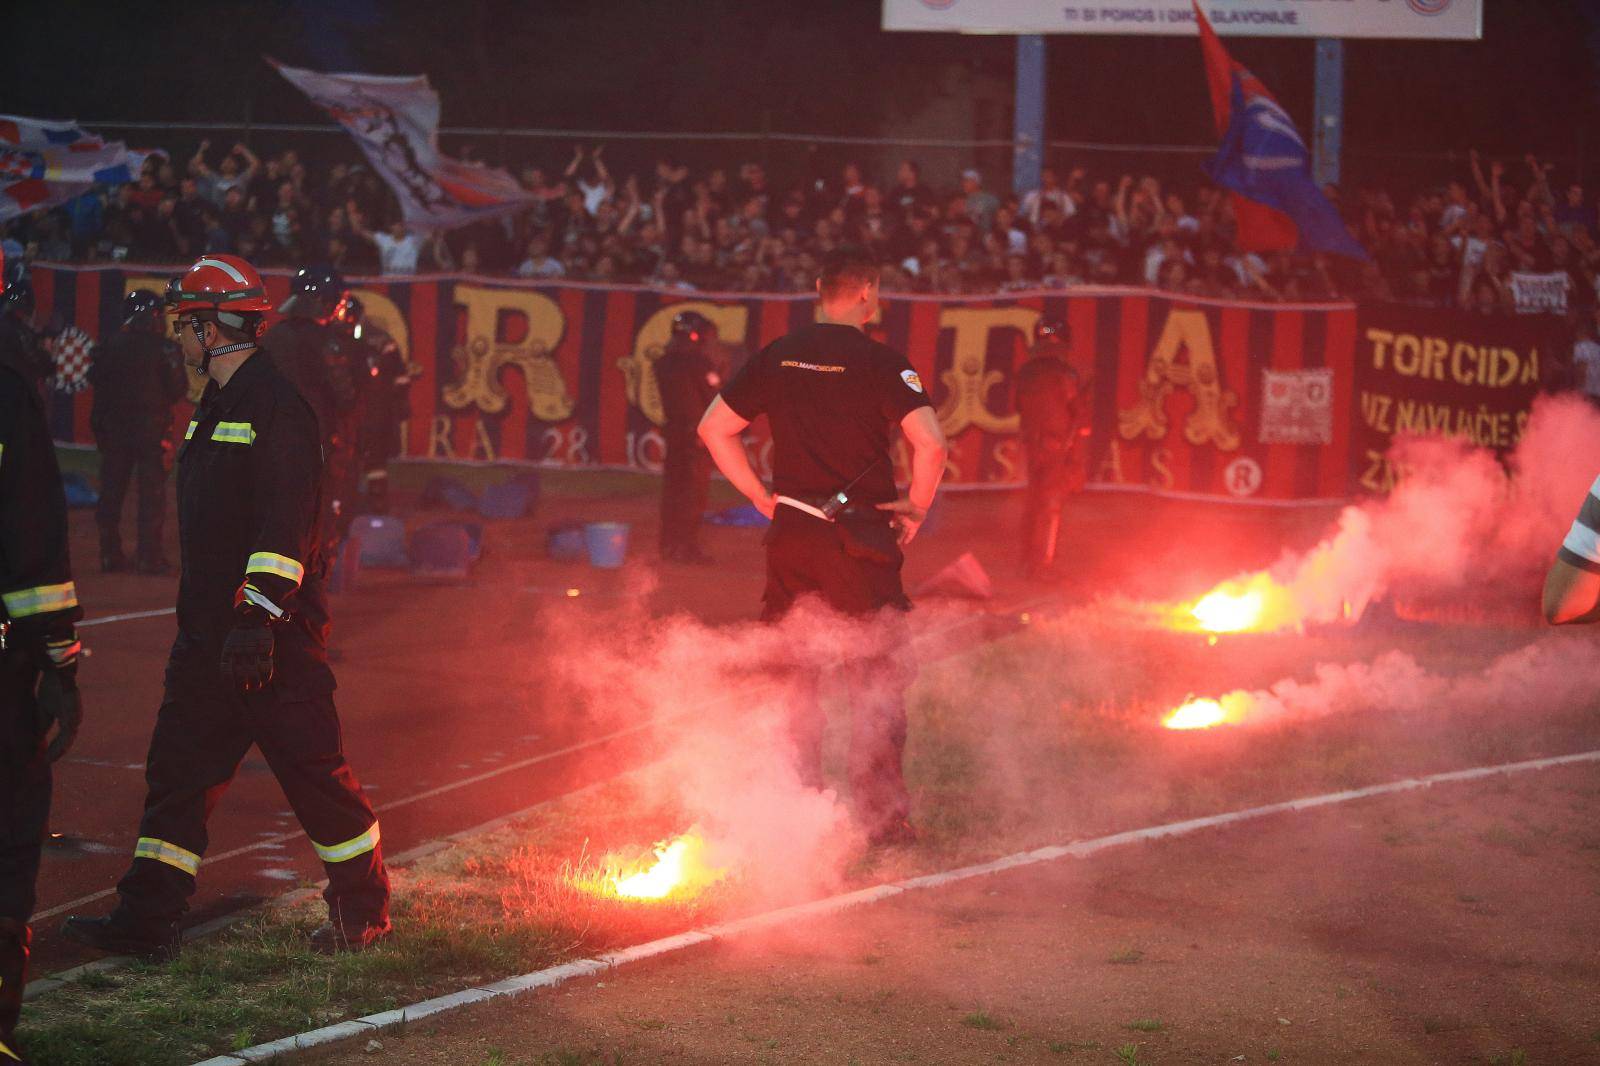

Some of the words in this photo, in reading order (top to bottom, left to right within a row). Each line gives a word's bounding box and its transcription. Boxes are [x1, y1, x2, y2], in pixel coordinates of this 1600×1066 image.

[1101, 7, 1154, 22] PONOS
[1167, 8, 1199, 23] DIK
[1210, 9, 1299, 25] SLAVONIJE
[125, 278, 1240, 451] RCDA
[1366, 327, 1540, 388] TORCIDA
[542, 426, 591, 467] 28
